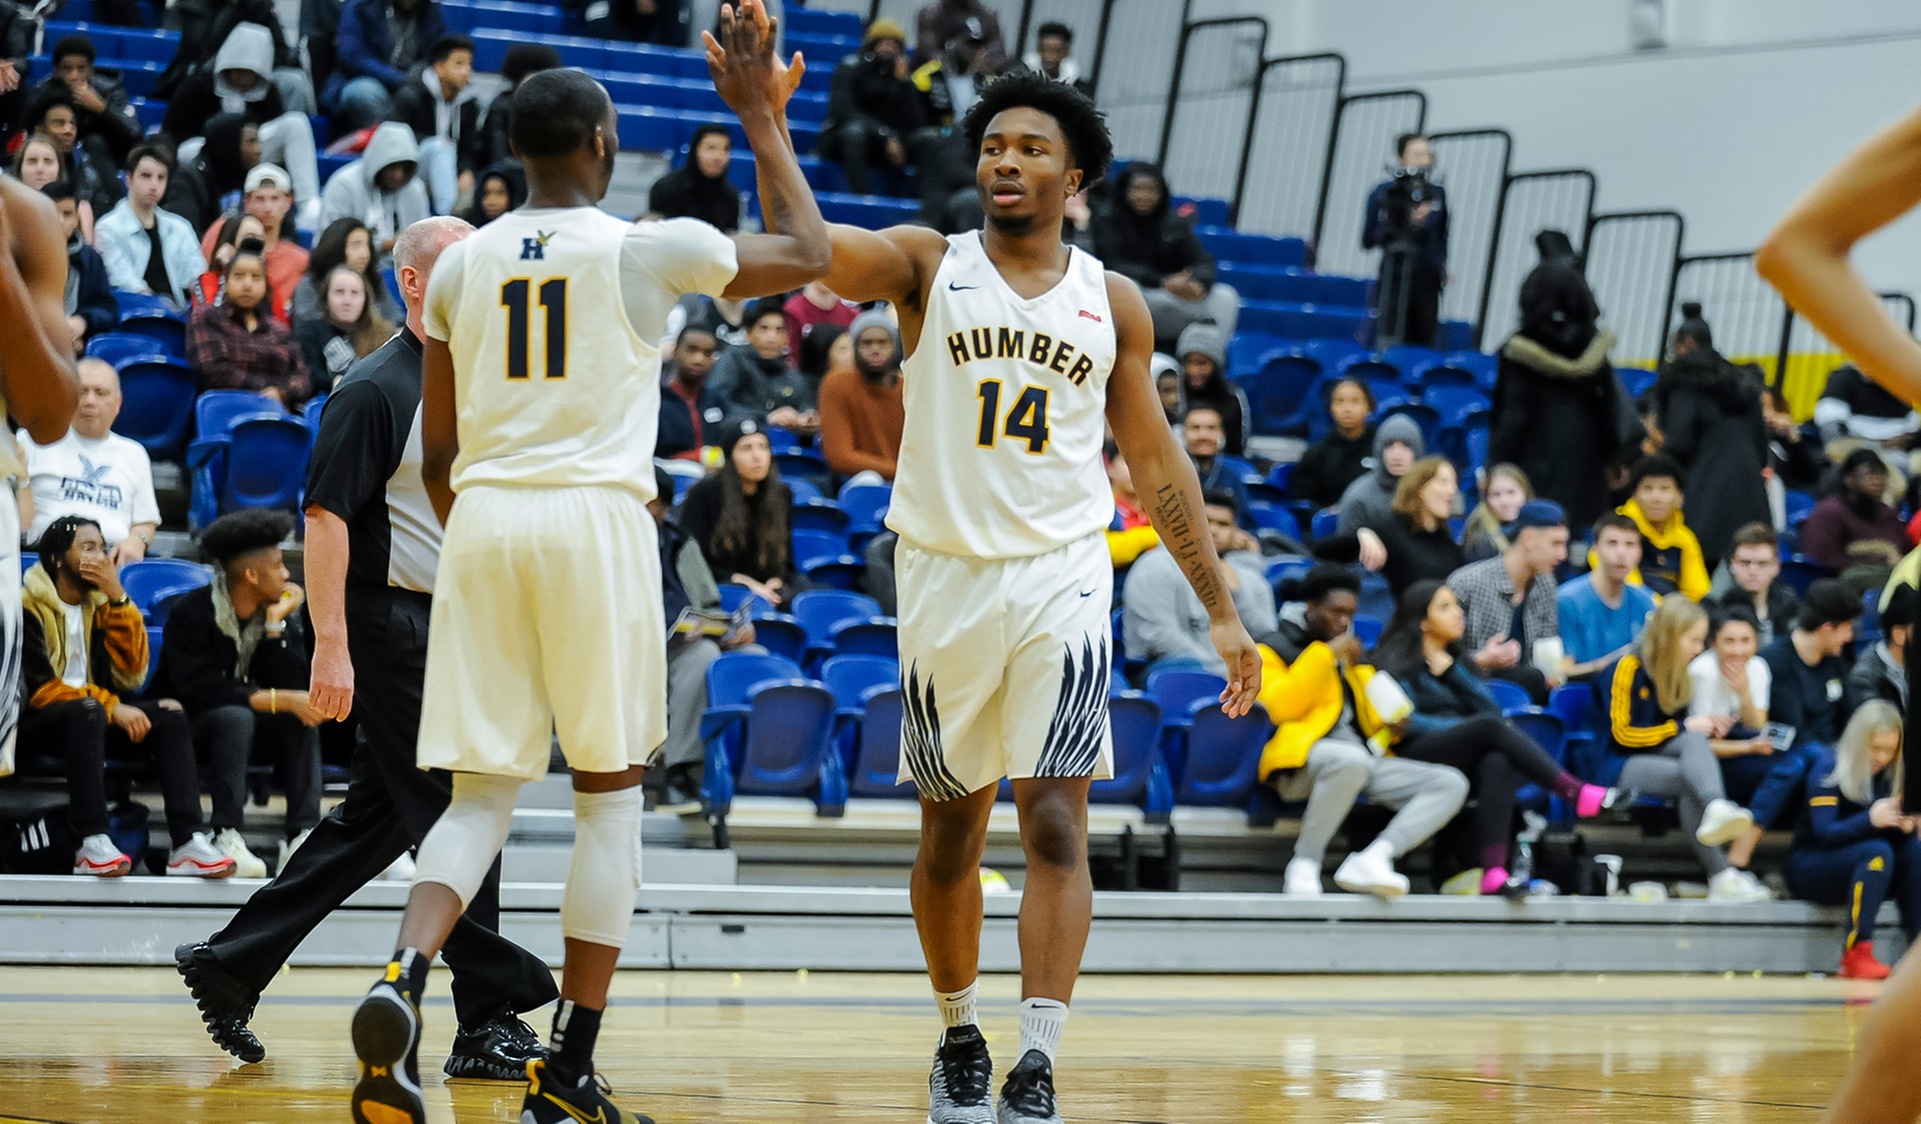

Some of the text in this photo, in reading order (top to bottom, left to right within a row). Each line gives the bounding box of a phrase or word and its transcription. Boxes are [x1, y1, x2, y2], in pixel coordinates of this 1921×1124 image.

[500, 276, 570, 381] 11
[947, 326, 1094, 387] HUMBER
[976, 378, 1051, 456] 14
